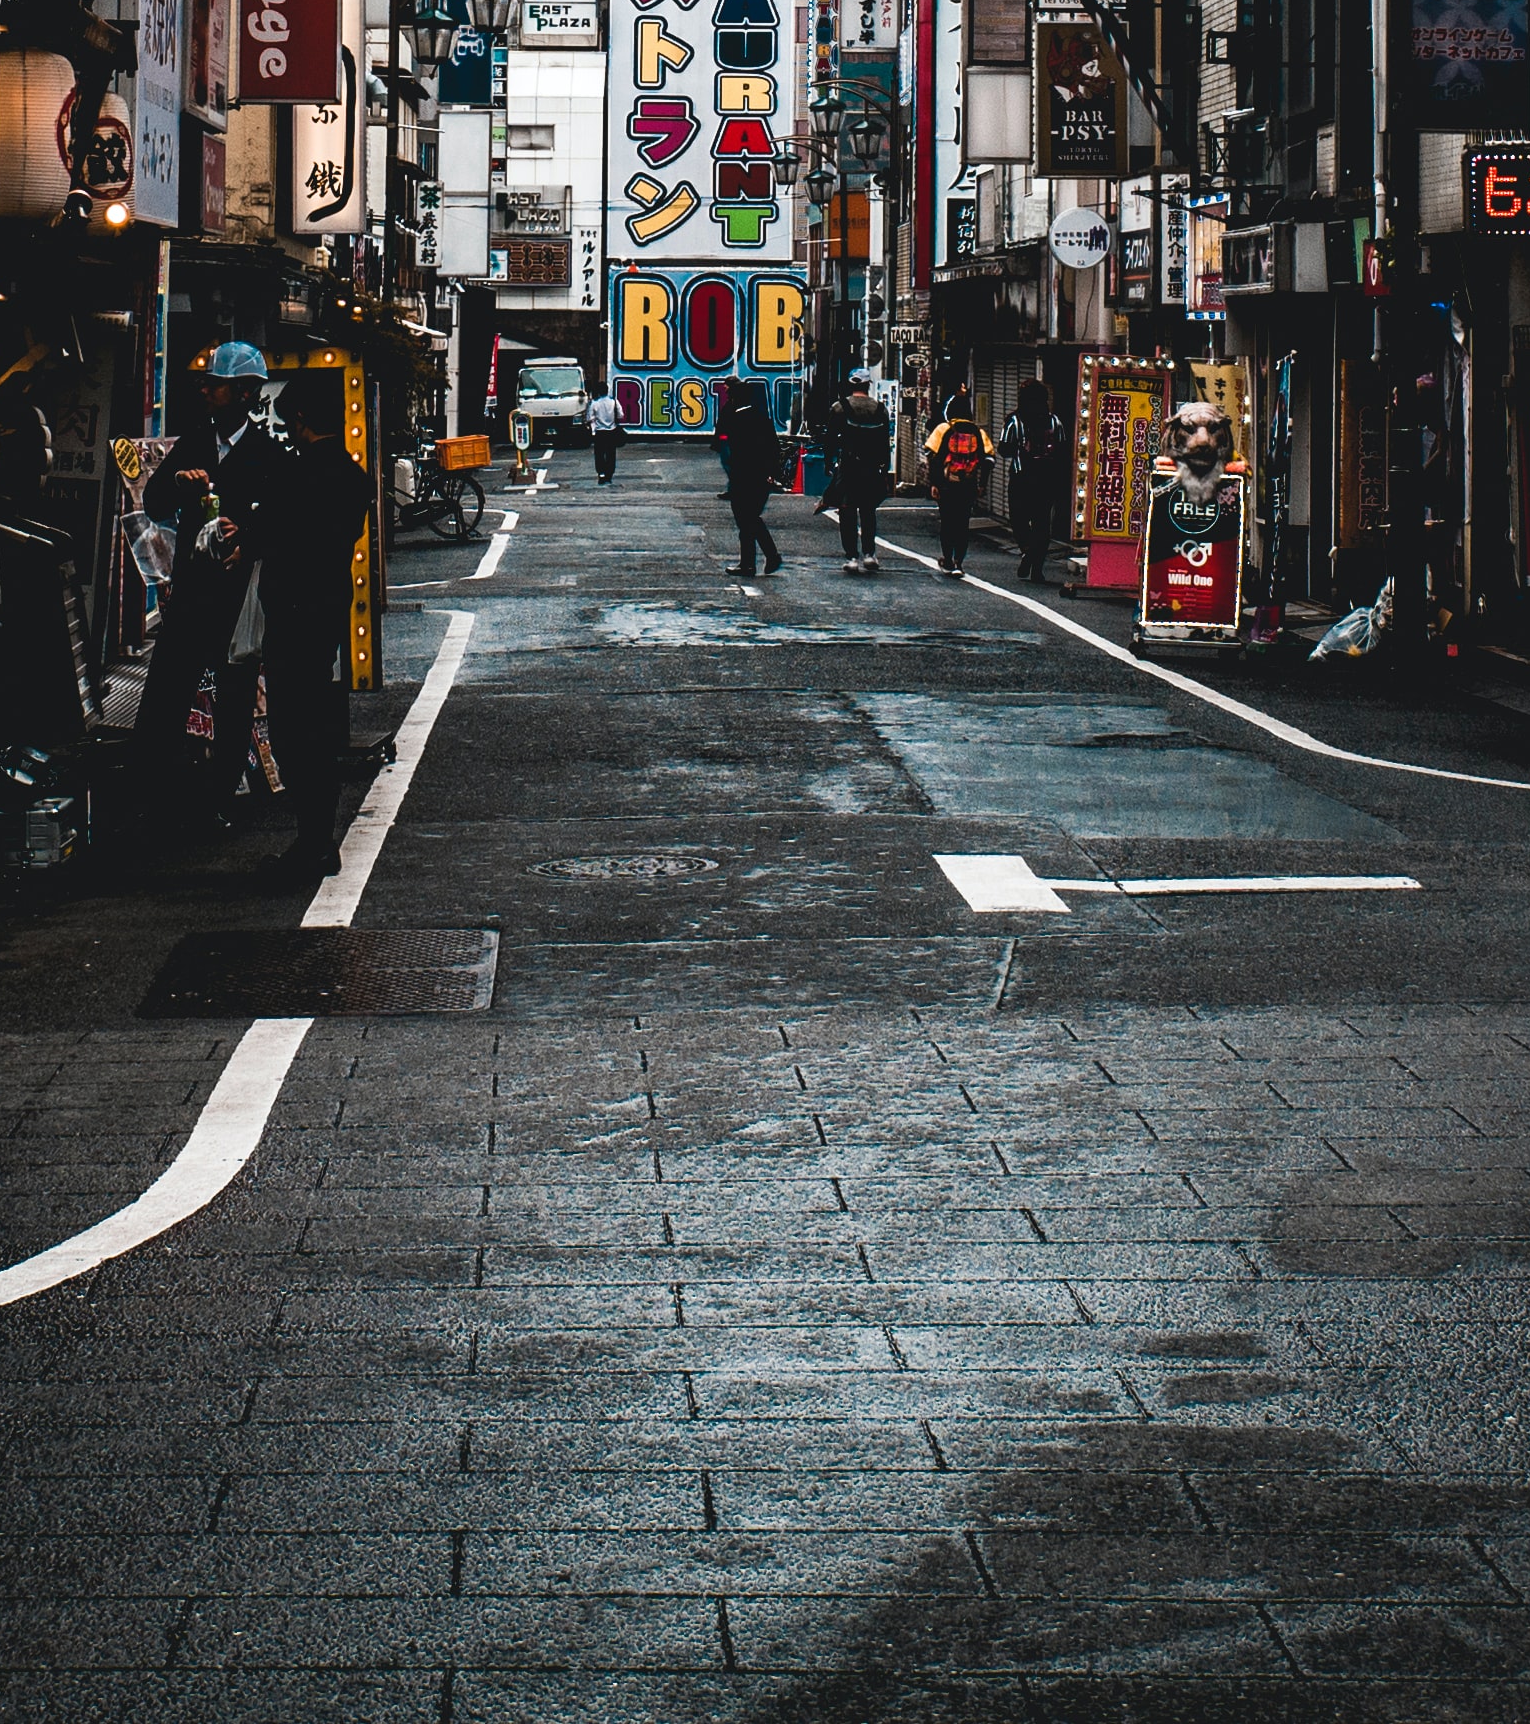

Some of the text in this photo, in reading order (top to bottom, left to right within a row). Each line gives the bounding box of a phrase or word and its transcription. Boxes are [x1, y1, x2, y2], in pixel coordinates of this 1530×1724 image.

[529, 5, 591, 32] EAST PLAZA
[1065, 110, 1104, 122] BAR
[420, 185, 442, 210] 茶
[615, 272, 810, 374] ROB
[1094, 393, 1129, 532] 無料情報館
[1172, 502, 1217, 517] FREE
[1167, 572, 1214, 587] Wild One
